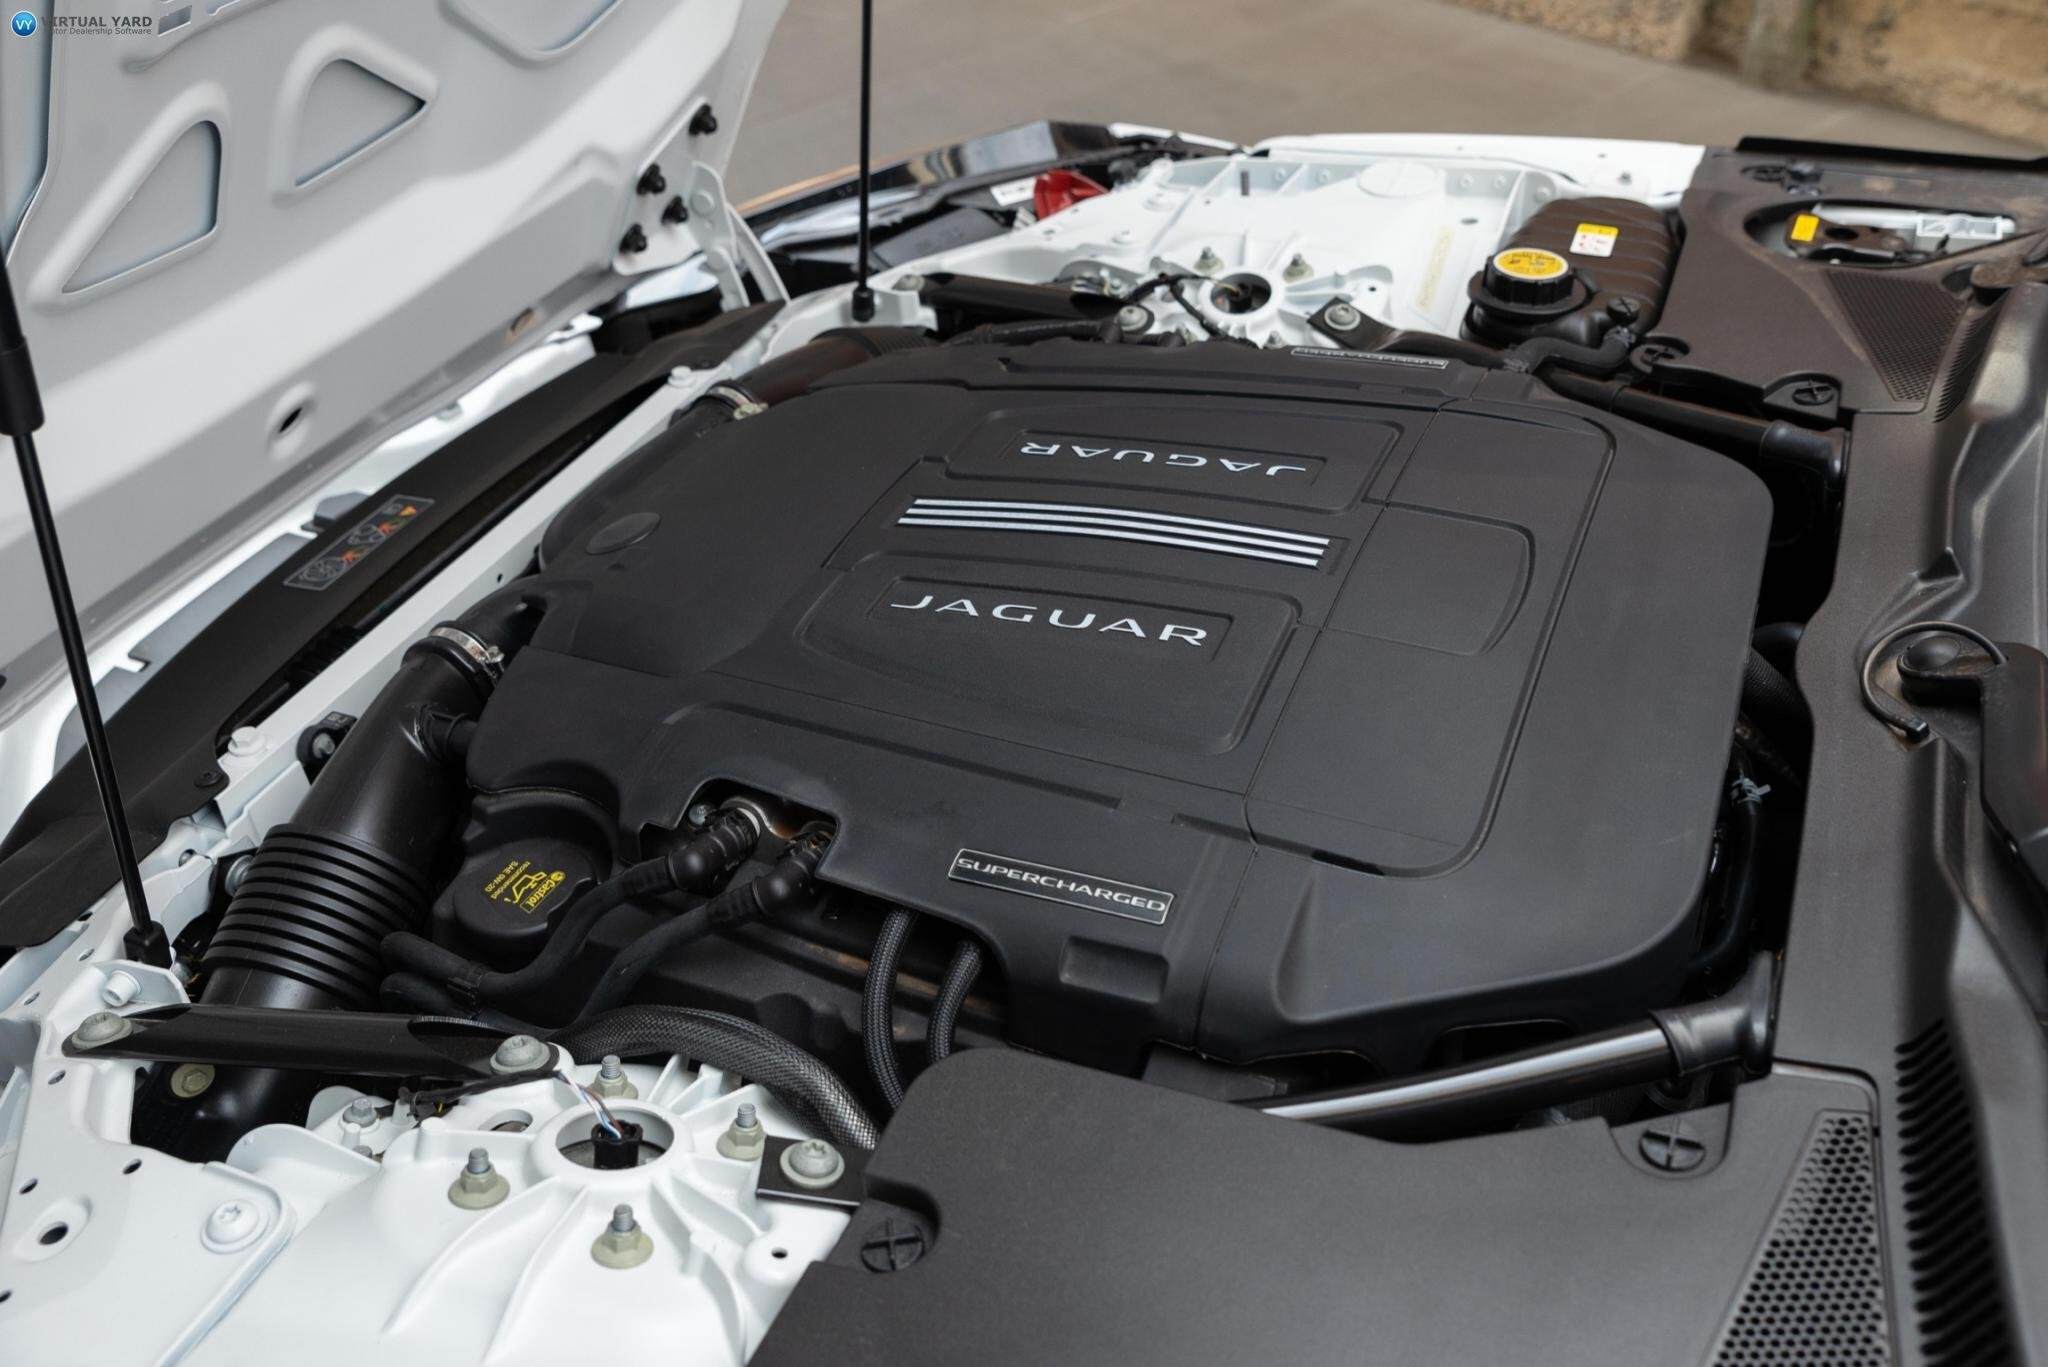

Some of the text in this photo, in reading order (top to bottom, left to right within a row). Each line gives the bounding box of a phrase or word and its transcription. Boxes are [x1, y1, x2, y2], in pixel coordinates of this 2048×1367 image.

[1020, 441, 1306, 476] JAGUAR
[890, 595, 1207, 647] JAGUAR
[490, 860, 531, 900] recommended
[525, 878, 556, 908] Castrol
[956, 858, 1166, 912] SUPERCHARGED
